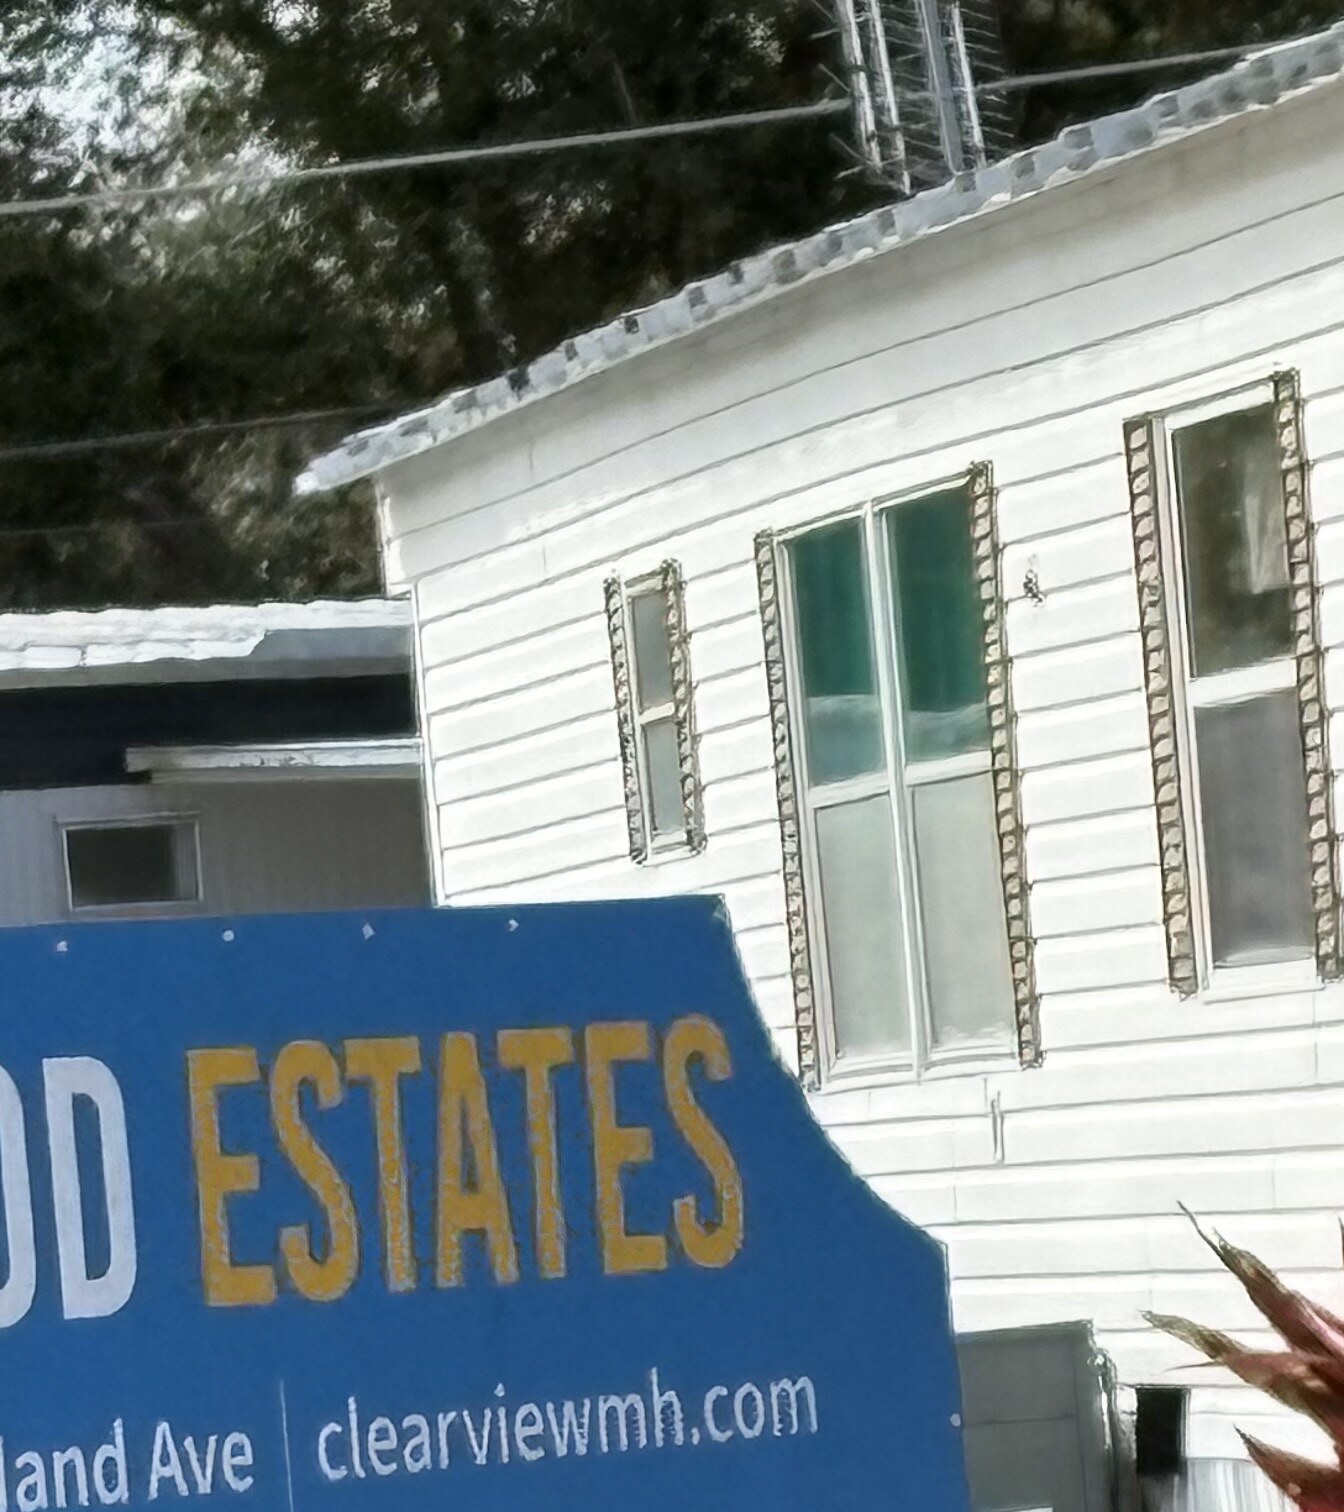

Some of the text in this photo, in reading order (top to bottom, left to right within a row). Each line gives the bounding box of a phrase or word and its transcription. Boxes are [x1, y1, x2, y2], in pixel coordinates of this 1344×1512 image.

[185, 1014, 746, 1308] ESTATES
[148, 1420, 255, 1500] Ave
[316, 1366, 819, 1482] clearviewmh.com
